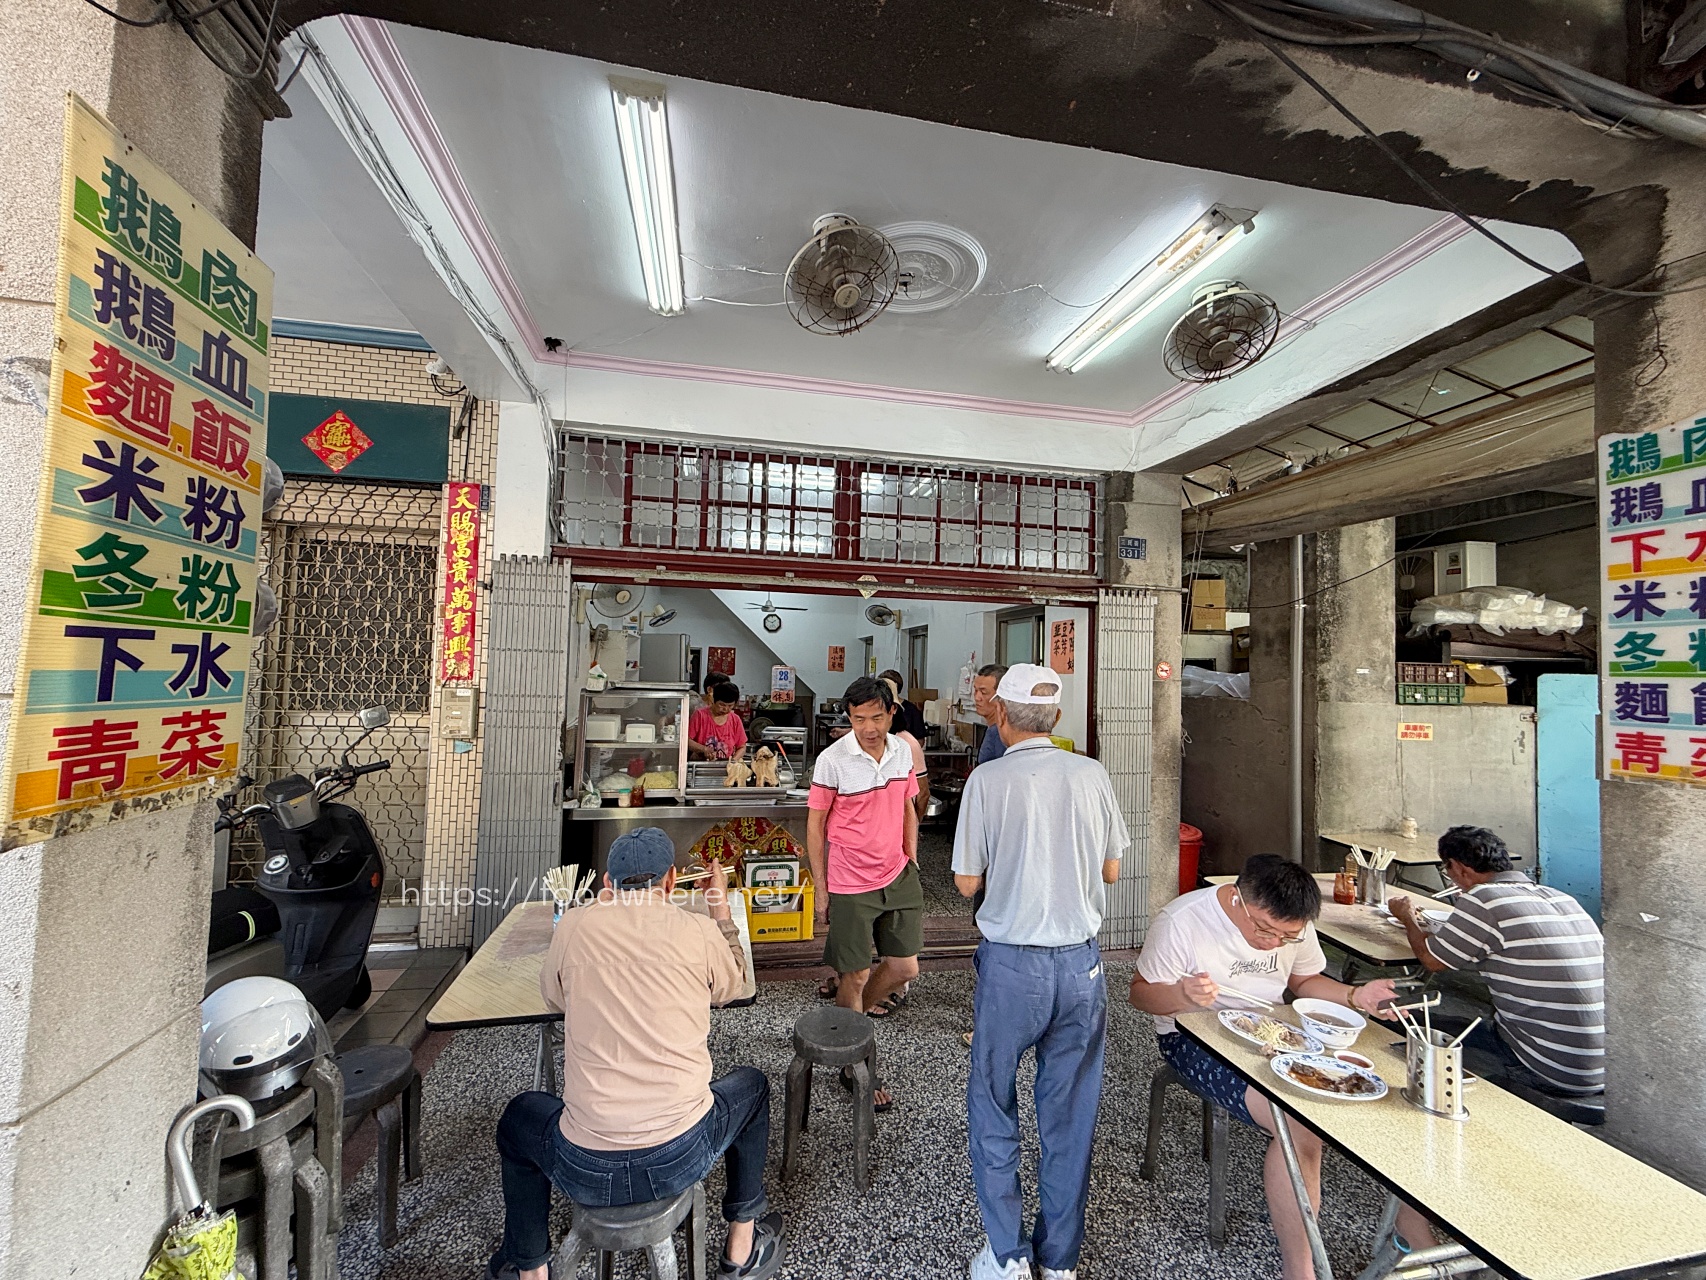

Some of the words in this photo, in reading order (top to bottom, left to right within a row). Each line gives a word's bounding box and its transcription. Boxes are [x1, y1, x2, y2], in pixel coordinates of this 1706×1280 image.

[101, 156, 258, 337] 鵝肉
[93, 248, 254, 410] 鵝血
[78, 440, 247, 549] 米粉
[72, 532, 241, 623] 冬粉
[1120, 548, 1138, 558] 331
[64, 624, 232, 702] 下水
[772, 690, 794, 702] 休息
[778, 670, 789, 681] 28
[47, 709, 227, 800] 青菜
